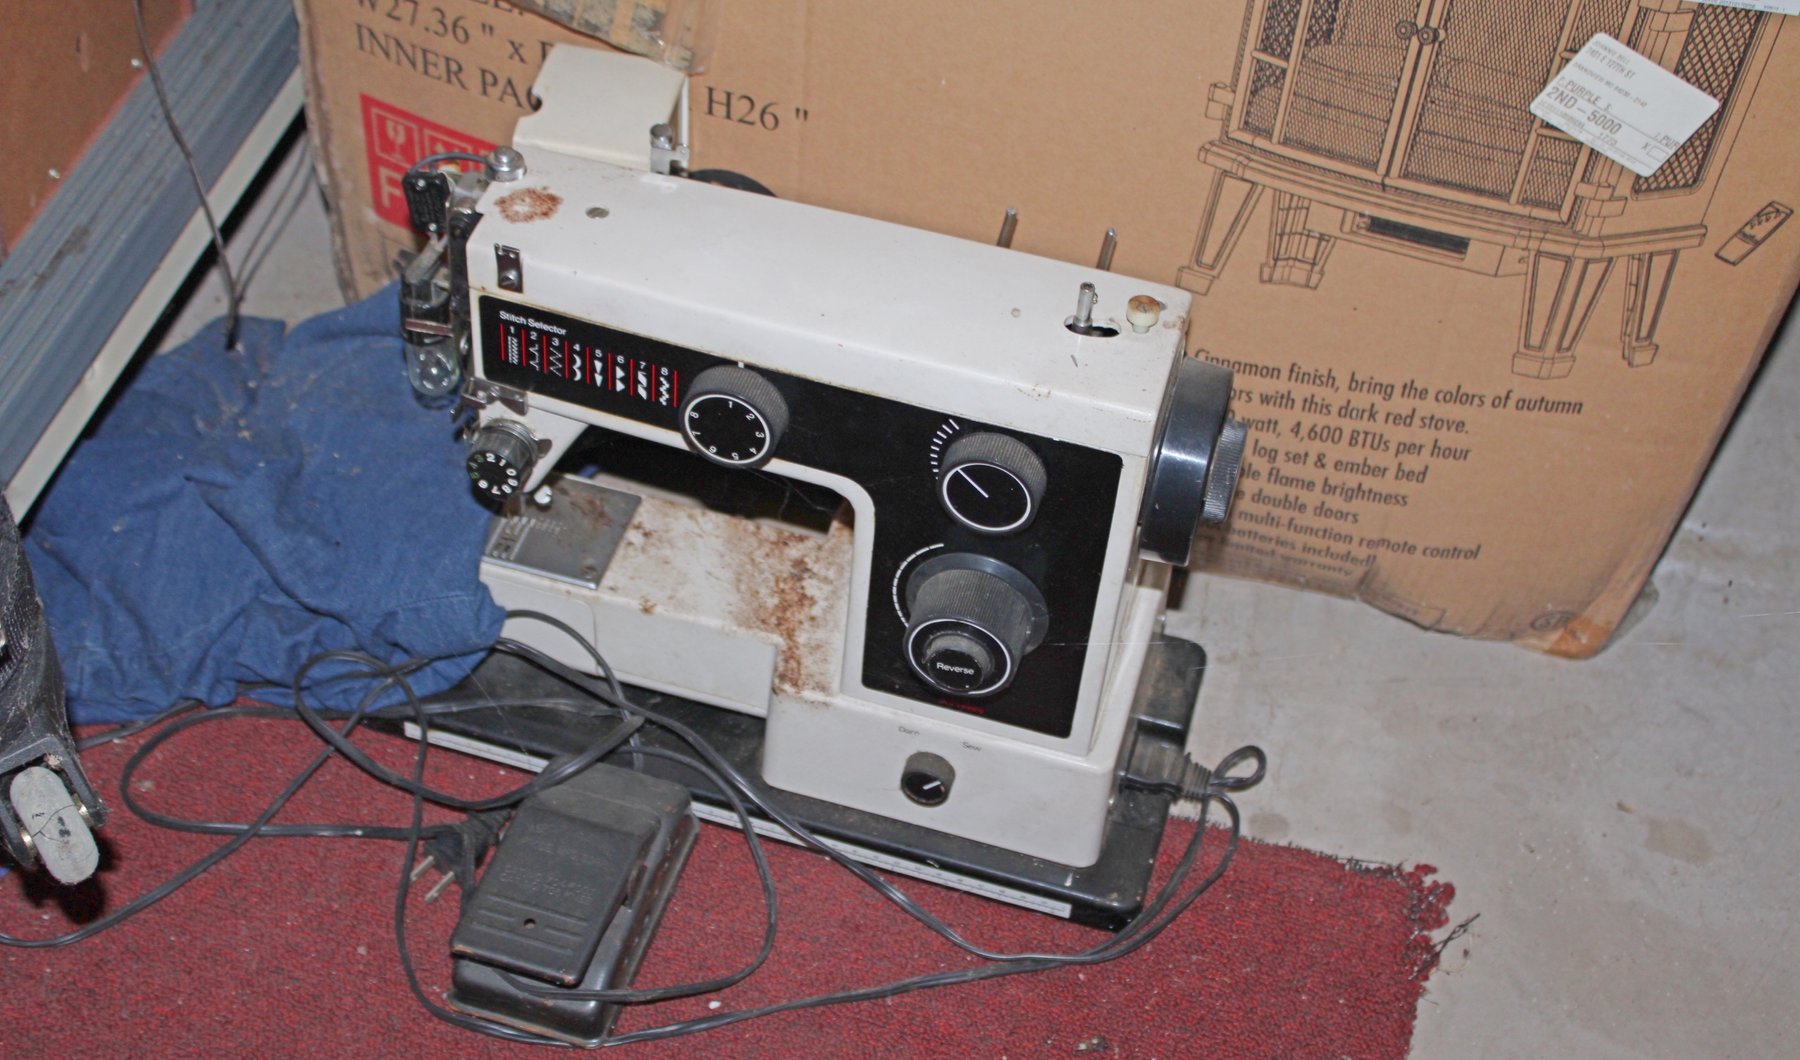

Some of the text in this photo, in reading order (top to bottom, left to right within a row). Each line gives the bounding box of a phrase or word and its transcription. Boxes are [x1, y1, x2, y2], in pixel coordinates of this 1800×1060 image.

[355, 22, 469, 91] INNER
[706, 86, 780, 131] H26
[1564, 80, 1601, 106] PURPLE
[1546, 86, 1579, 112] 2ND
[1587, 109, 1623, 135] 5000
[499, 310, 568, 336] Stitch Selector
[509, 326, 669, 376] 1 2 3 4 5 6 7 8
[1288, 362, 1340, 393] finish,
[1348, 371, 1395, 402] bring
[1401, 379, 1429, 400] the
[1434, 385, 1486, 408] colors
[1491, 389, 1514, 409] of
[1515, 396, 1584, 415] autumn
[689, 411, 699, 419] 8
[728, 401, 733, 409] 1
[745, 413, 756, 421] 2
[1259, 390, 1296, 411] with
[1302, 394, 1334, 416] this
[1337, 399, 1379, 423] dark
[1384, 407, 1417, 428] red
[1419, 413, 1470, 434] stove.
[709, 445, 718, 454] 6
[731, 452, 739, 460] 5
[749, 447, 757, 455] 4
[1290, 420, 1343, 445] 4,600
[1348, 429, 1390, 452] BTUs
[1395, 440, 1426, 458] per
[1430, 438, 1473, 462] hour
[1252, 438, 1430, 484] log set & ember bed
[1267, 466, 1316, 492] flame
[1321, 476, 1409, 507] brightness
[1251, 487, 1308, 514] double
[1313, 500, 1360, 525] doors
[1238, 510, 1354, 546] multi-function
[1359, 536, 1418, 556] remote
[1421, 543, 1483, 561] control
[936, 662, 975, 675] Reverse
[898, 725, 920, 737] Darn
[961, 741, 982, 752] Sew
